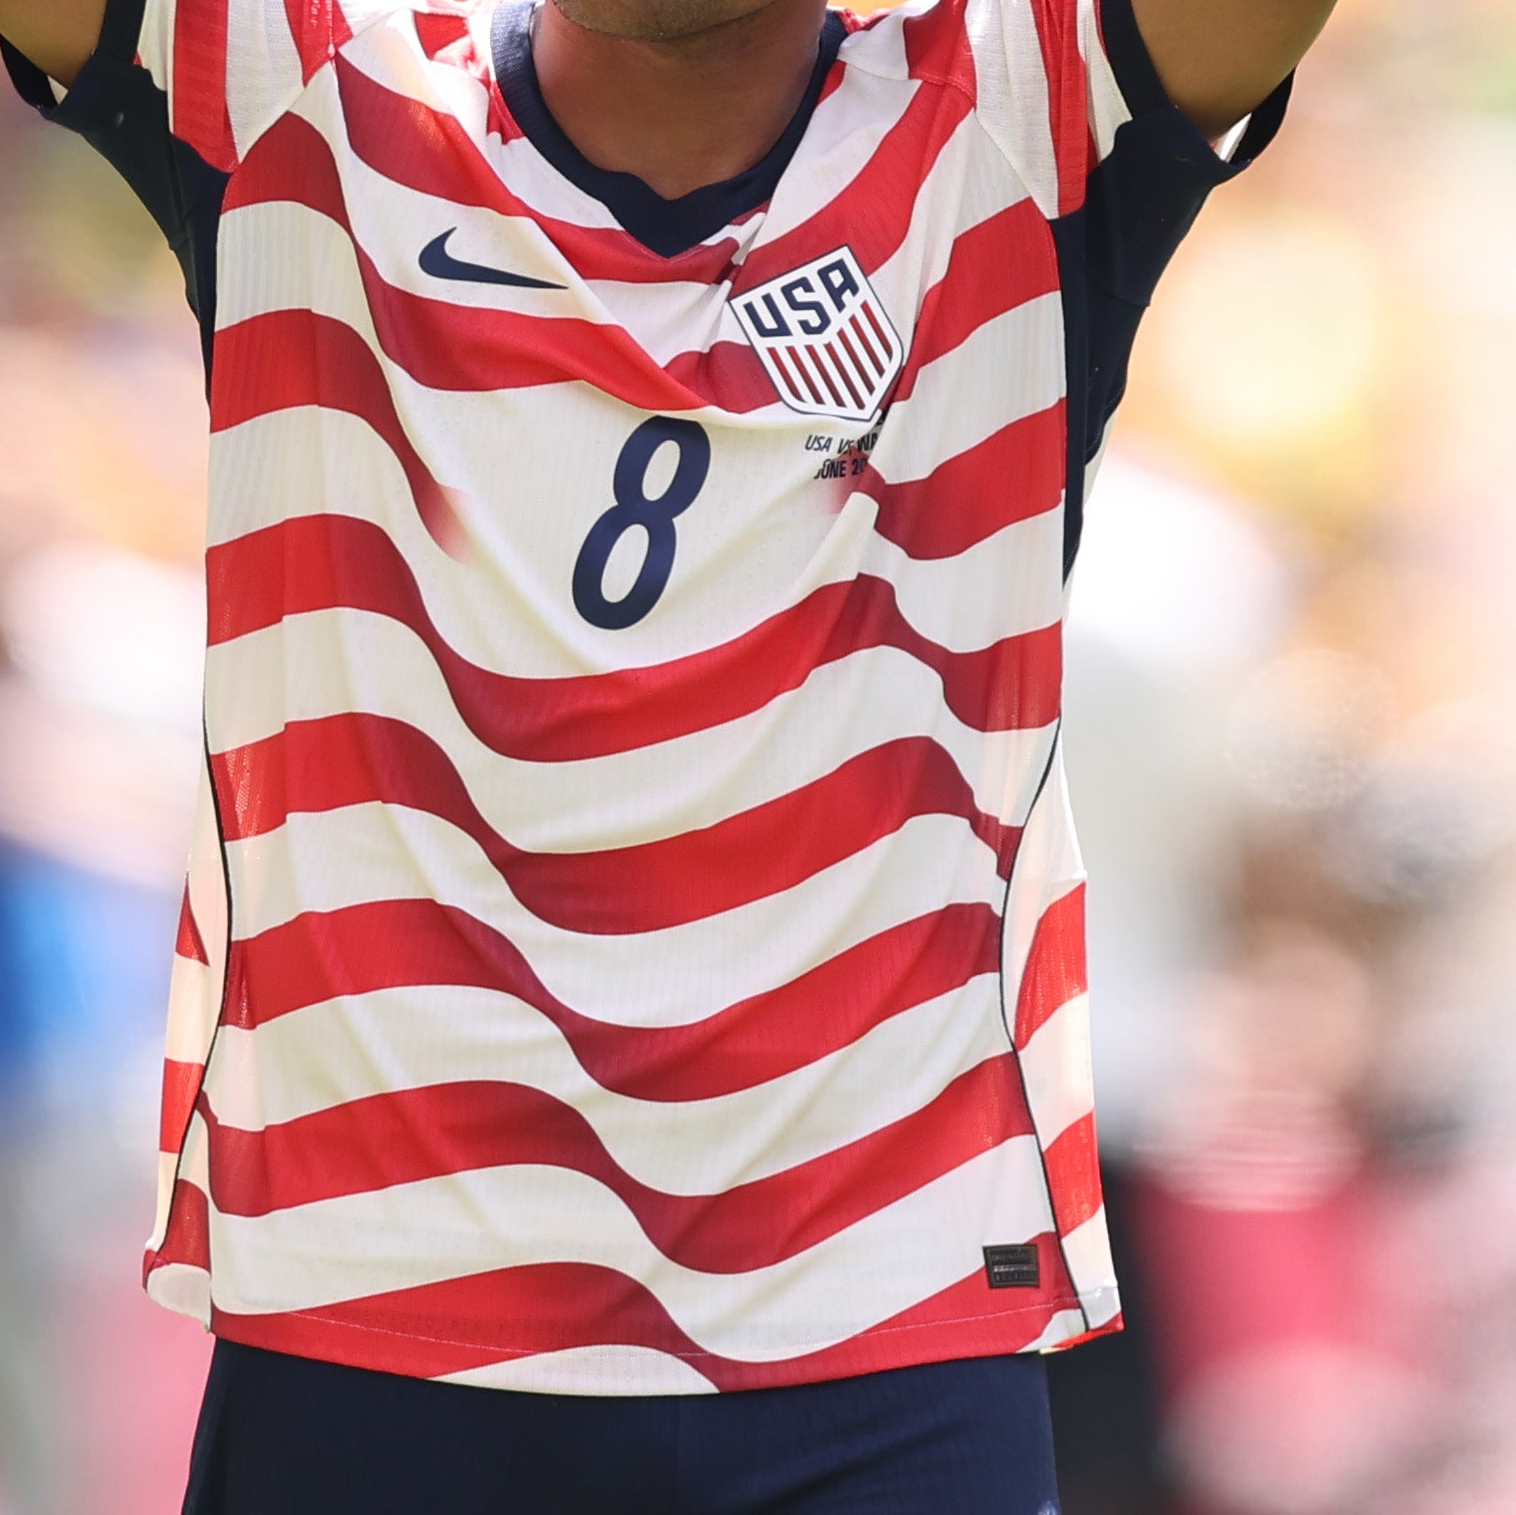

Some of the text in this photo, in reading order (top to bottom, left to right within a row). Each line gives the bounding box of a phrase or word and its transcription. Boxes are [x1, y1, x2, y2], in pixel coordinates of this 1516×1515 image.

[743, 258, 860, 338] USA
[805, 435, 833, 452] USA
[572, 415, 711, 630] 8
